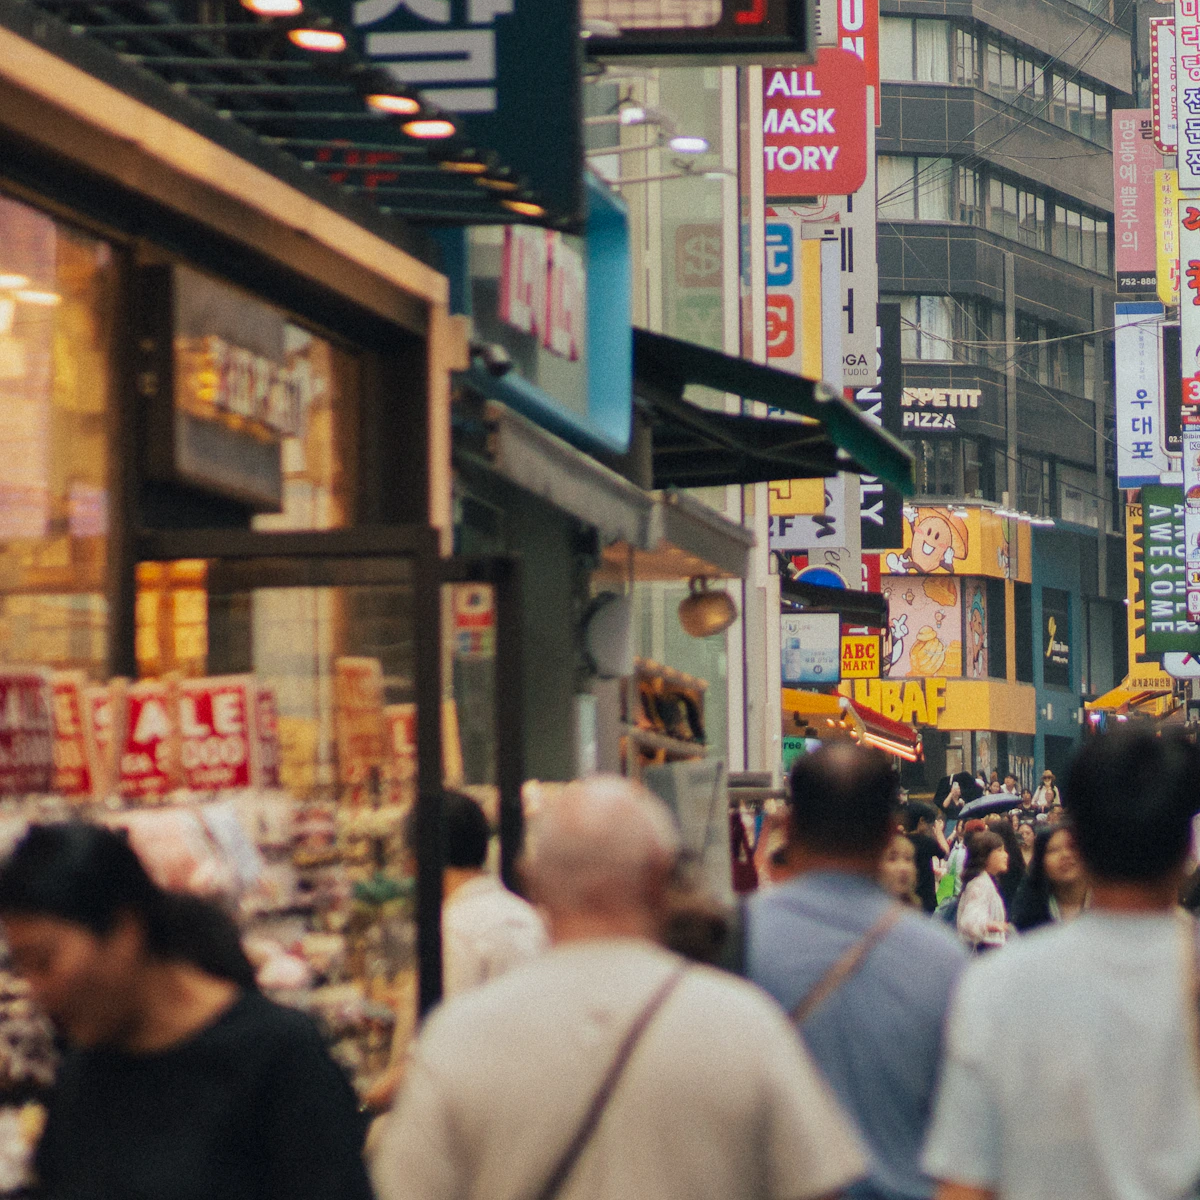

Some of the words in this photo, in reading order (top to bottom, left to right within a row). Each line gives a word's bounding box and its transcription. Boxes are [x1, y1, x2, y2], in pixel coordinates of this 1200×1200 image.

[766, 70, 821, 97] ALL
[843, 368, 869, 376] TUDIO
[903, 411, 956, 428] PIZZA
[1130, 388, 1154, 459] 우대포
[1148, 503, 1174, 633] AWESOME
[842, 643, 875, 659] ABC
[842, 660, 875, 670] MART
